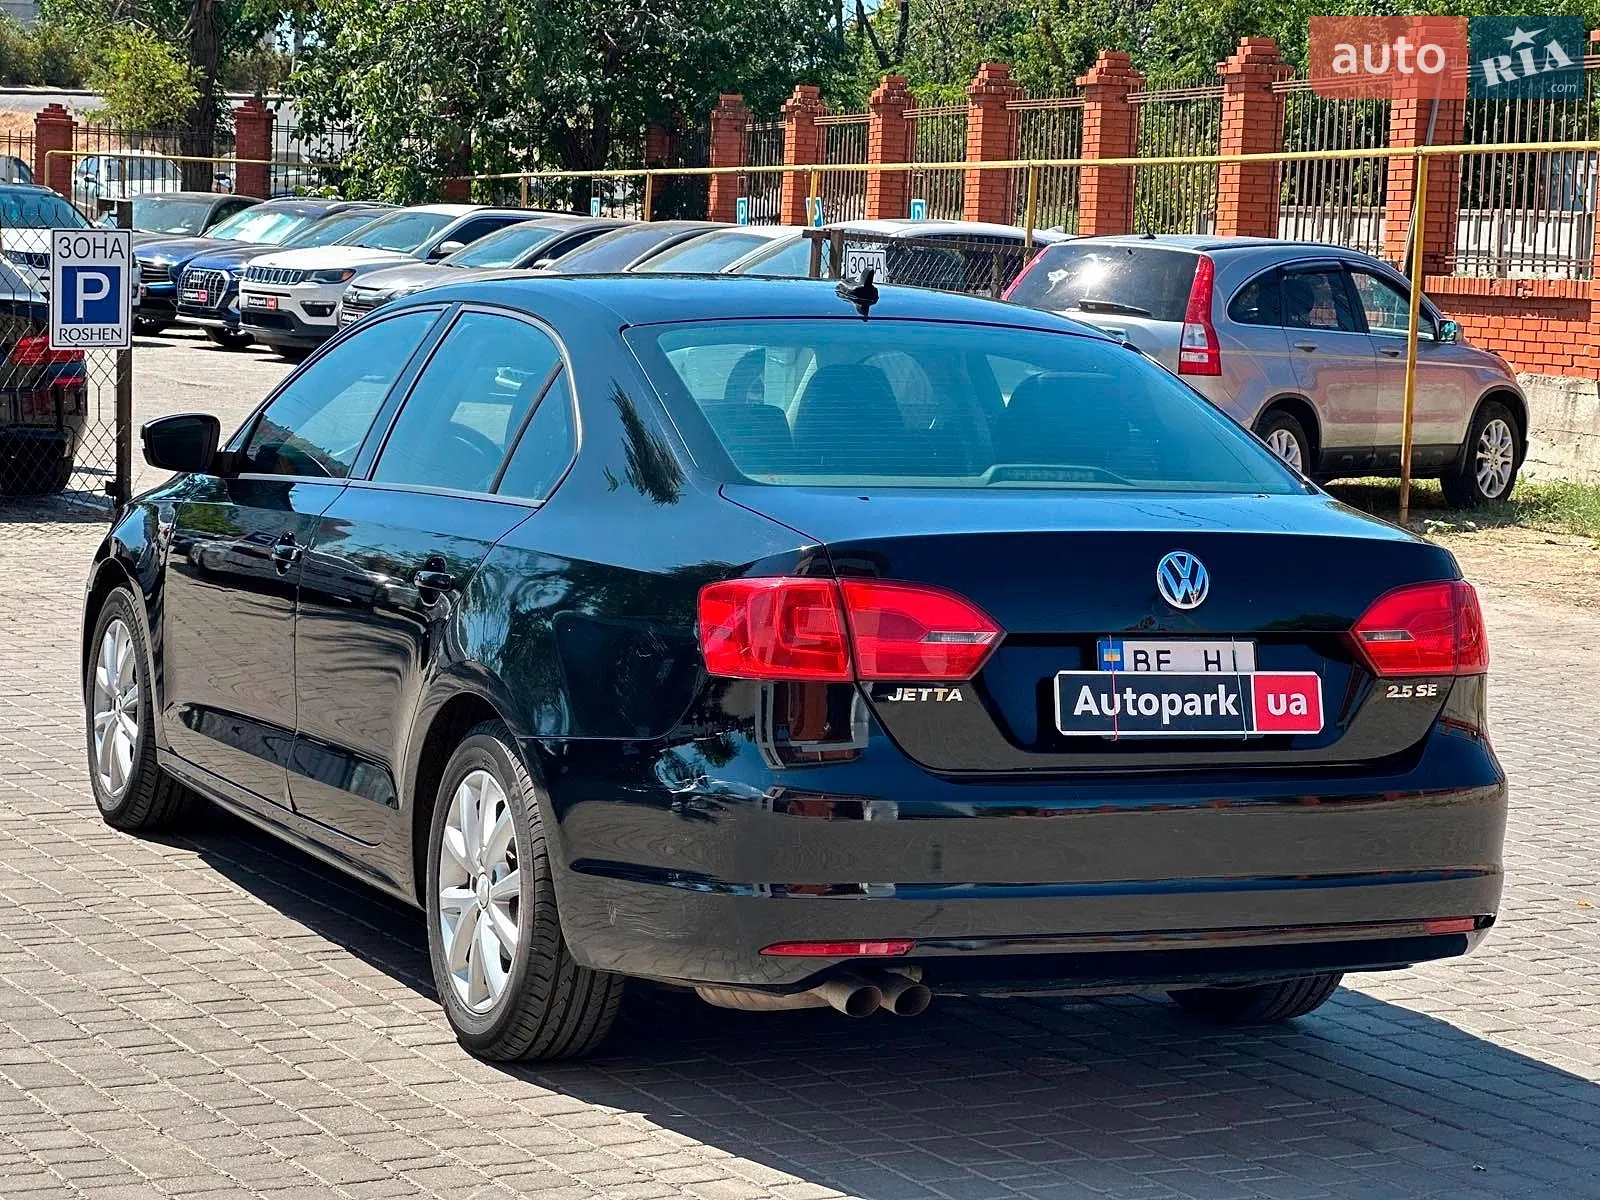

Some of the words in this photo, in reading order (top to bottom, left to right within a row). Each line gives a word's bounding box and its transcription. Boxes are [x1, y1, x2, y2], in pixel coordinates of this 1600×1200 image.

[58, 236, 125, 259] ЗОНА
[76, 271, 111, 319] P
[59, 328, 122, 343] ROSHEN
[887, 687, 963, 702] JETTA
[1415, 684, 1438, 697] SE
[1073, 685, 1240, 725] Autopark
[1266, 692, 1308, 716] ua
